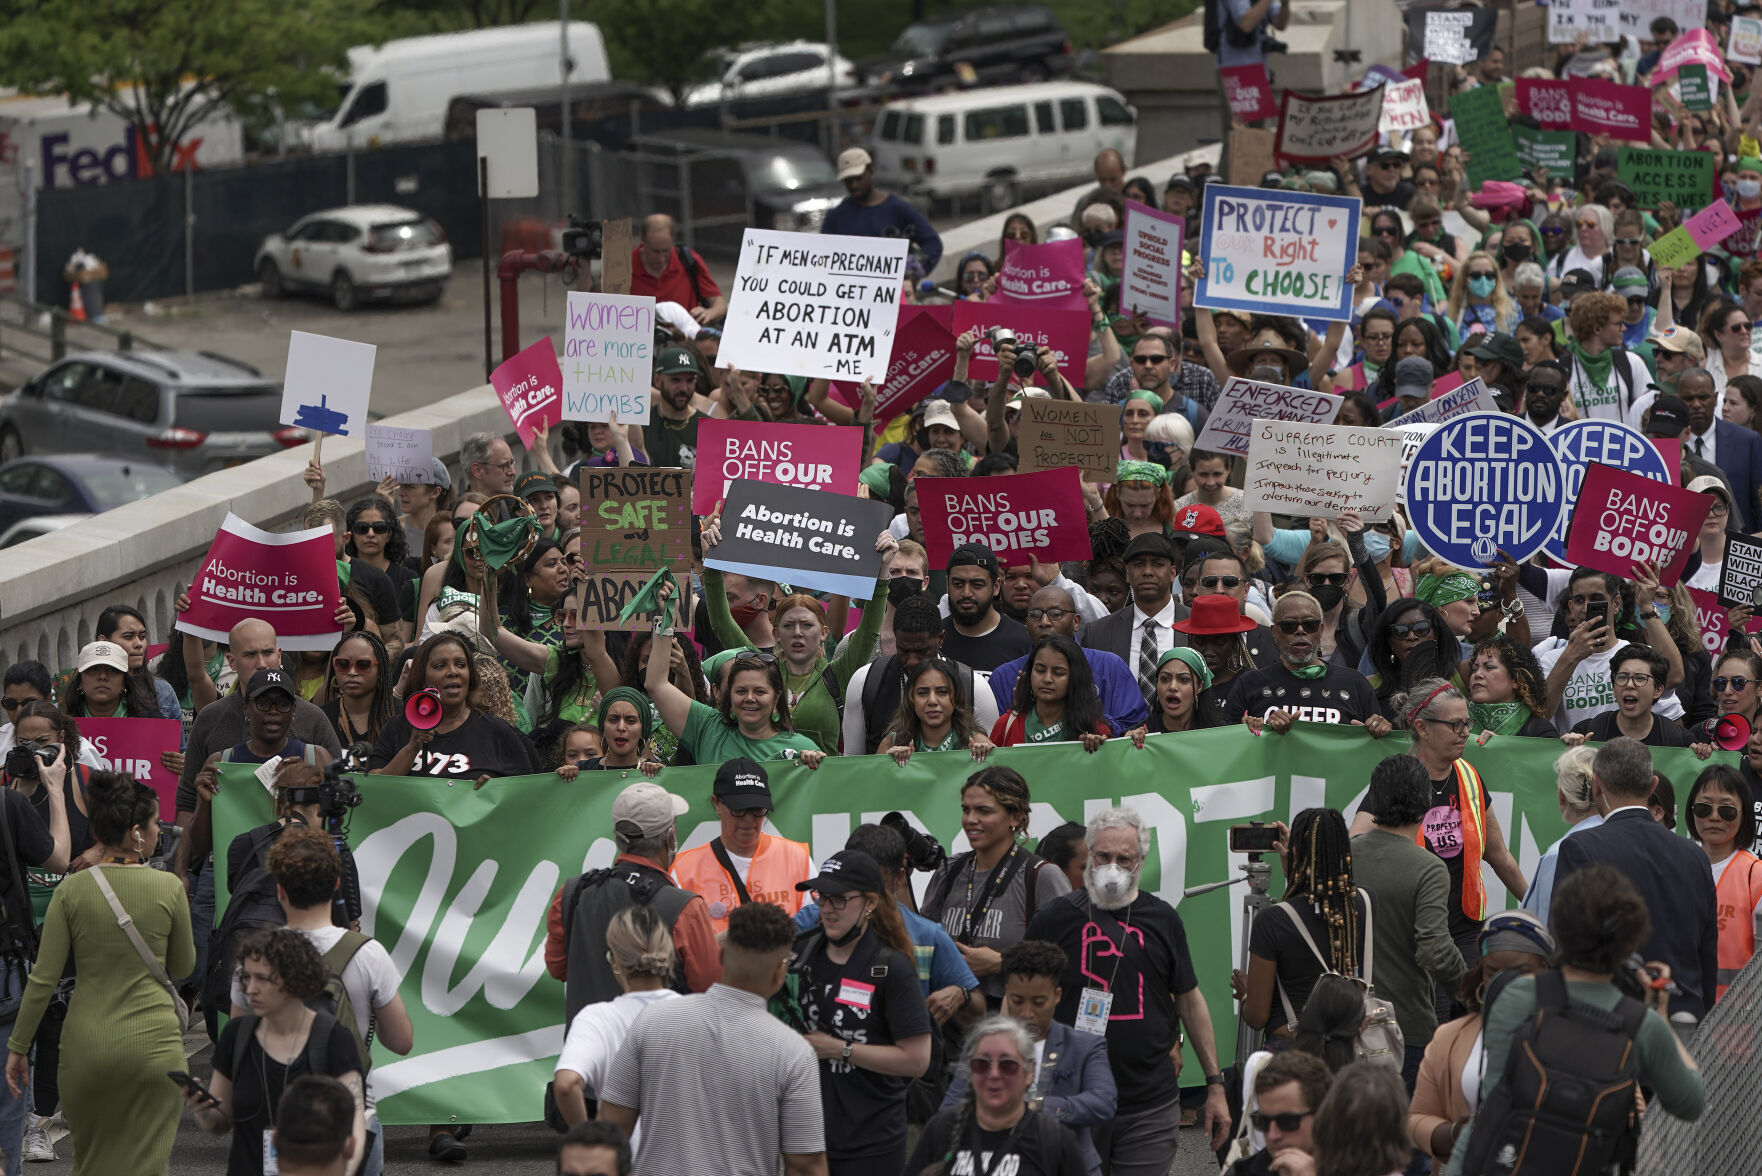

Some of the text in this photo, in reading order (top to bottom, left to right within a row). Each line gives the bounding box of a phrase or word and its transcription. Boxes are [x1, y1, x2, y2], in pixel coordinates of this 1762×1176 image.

[1530, 87, 1568, 100] BANS
[1577, 92, 1624, 111] Abortion is
[1532, 109, 1570, 122] BODI
[1577, 103, 1639, 124] Health Care.
[1626, 151, 1704, 169] ABORTION
[1632, 171, 1698, 188] ACCESS
[1217, 199, 1322, 236] PROTECT
[1138, 230, 1168, 247] UPHOLD
[1139, 240, 1165, 256] SOCIAL
[1133, 248, 1170, 267] PROGRESS
[1215, 233, 1320, 267] OUR Right
[779, 250, 809, 267] MEN
[810, 254, 831, 269] GOT
[830, 252, 903, 275] PREGNANT
[1003, 263, 1050, 279] Abortion is
[1211, 257, 1234, 285] TO
[741, 275, 896, 304] YOU COULD GET AN
[1001, 275, 1072, 294] Health Care.
[755, 300, 870, 329] ABORTION
[758, 327, 785, 344] AT
[791, 331, 818, 349] AN
[1037, 330, 1048, 344] is
[566, 338, 648, 359] are more
[903, 350, 918, 361] is
[908, 349, 945, 375] Care.
[528, 374, 538, 386] is
[527, 384, 555, 405] Care.
[567, 391, 645, 415] WOMBS
[1226, 381, 1332, 415] ENFORCED
[1575, 395, 1617, 408] BODIES
[1031, 404, 1097, 424] WOMEN
[1066, 429, 1101, 443] NOT
[1210, 418, 1252, 435] CRIM
[1404, 431, 1427, 443] TION
[725, 438, 793, 461] BANS
[1348, 433, 1400, 448] COURT
[1441, 419, 1534, 459] KEEP
[1558, 426, 1645, 466] KEEP
[1297, 447, 1360, 463] illegitimate
[722, 459, 833, 484] OFF OUR
[1256, 460, 1302, 474] Impeach
[1306, 464, 1323, 475] for
[589, 472, 683, 499] PROTECT
[1293, 483, 1317, 495] those
[1351, 489, 1363, 500] to
[1414, 461, 1555, 503] ABORTION
[944, 492, 1011, 513] BANS
[1262, 492, 1303, 504] overturn
[1305, 499, 1322, 508] our
[1606, 488, 1671, 523] BANS
[598, 500, 669, 531] SAFE
[740, 503, 856, 537] Abortion is
[947, 508, 1059, 533] OFF OUR
[1428, 503, 1542, 544] LEGAL
[1600, 510, 1688, 550] OFF OUR
[735, 522, 861, 561] Health Care.
[1593, 530, 1677, 569] BODIES
[1731, 540, 1762, 561] STAN
[592, 540, 675, 568] LEGAL
[206, 558, 298, 586] Abortion is
[1729, 557, 1760, 574] WITH
[202, 576, 324, 604] Health Care.
[1695, 609, 1723, 632] NS
[1564, 682, 1613, 698] OFF OU
[1566, 694, 1617, 710] BODIE
[735, 779, 755, 787] Health
